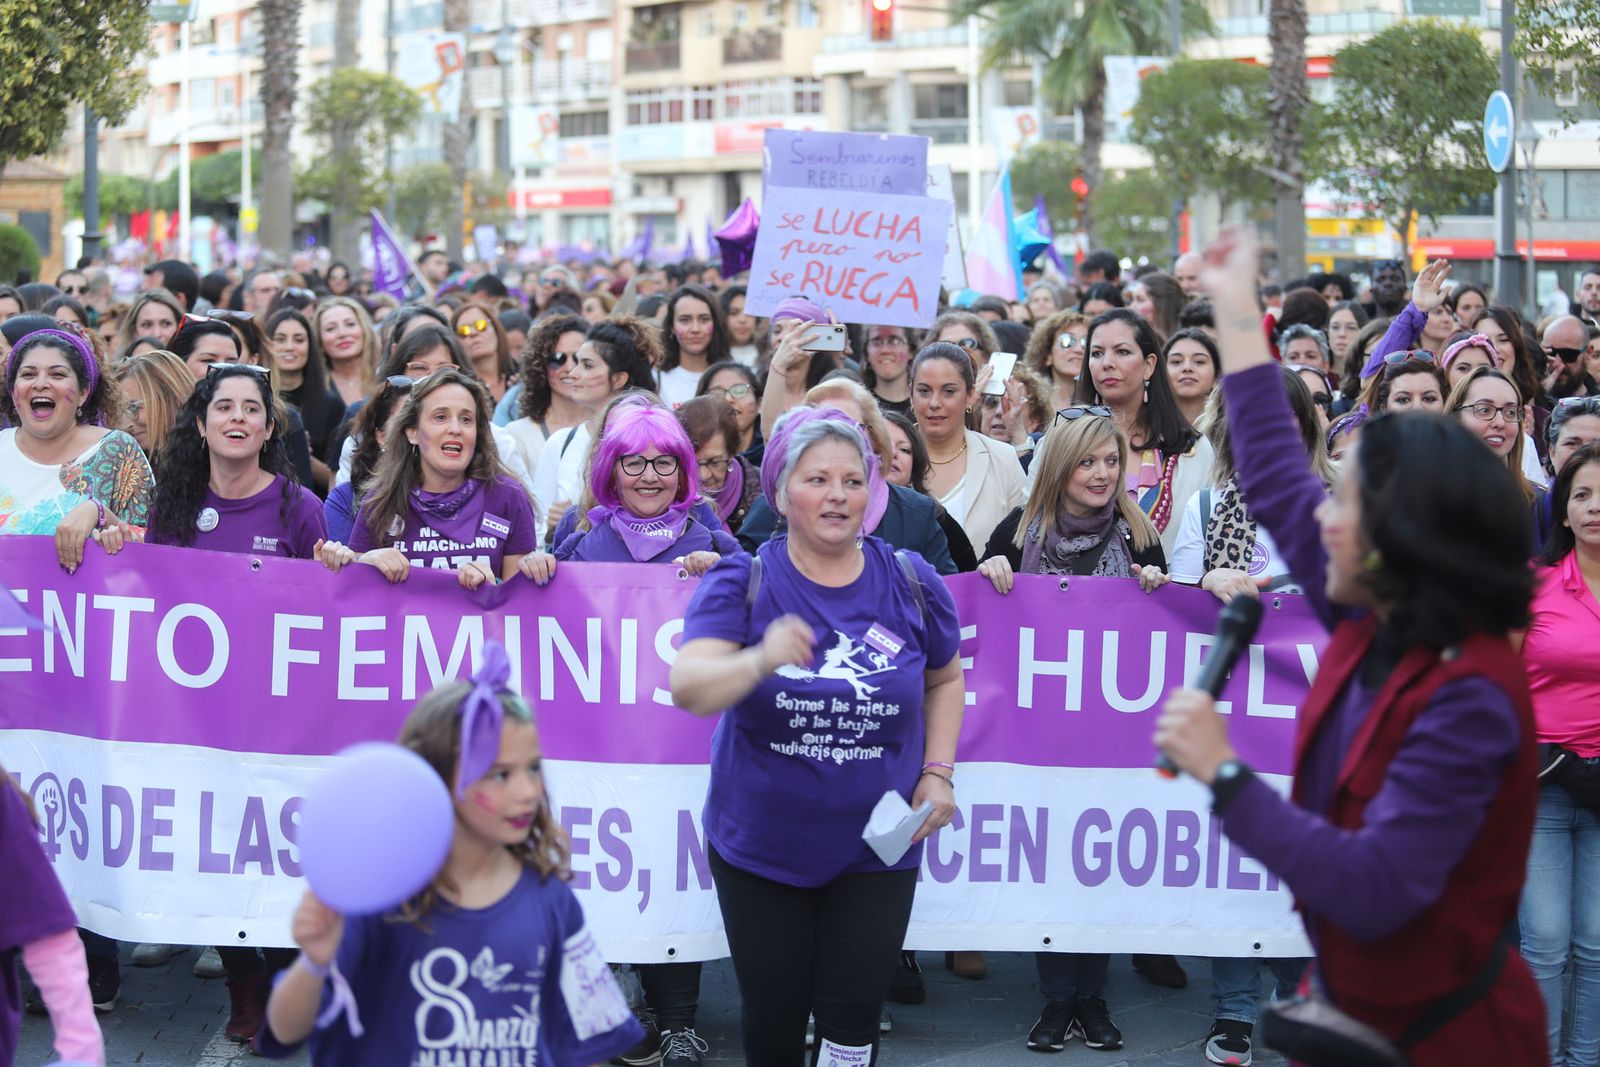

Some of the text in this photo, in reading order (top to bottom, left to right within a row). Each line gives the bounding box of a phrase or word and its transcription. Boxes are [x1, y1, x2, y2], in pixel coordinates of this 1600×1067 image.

[806, 168, 894, 190] REBELDÍA
[776, 207, 921, 244] se LUCHA
[779, 238, 923, 264] pero no
[766, 259, 920, 313] se RUEGA
[775, 691, 900, 717] Somos las nietas
[789, 713, 881, 739] de las brujas
[101, 784, 176, 872] DE
[916, 803, 1050, 885] CEN
[825, 1042, 868, 1056] Feminismo
